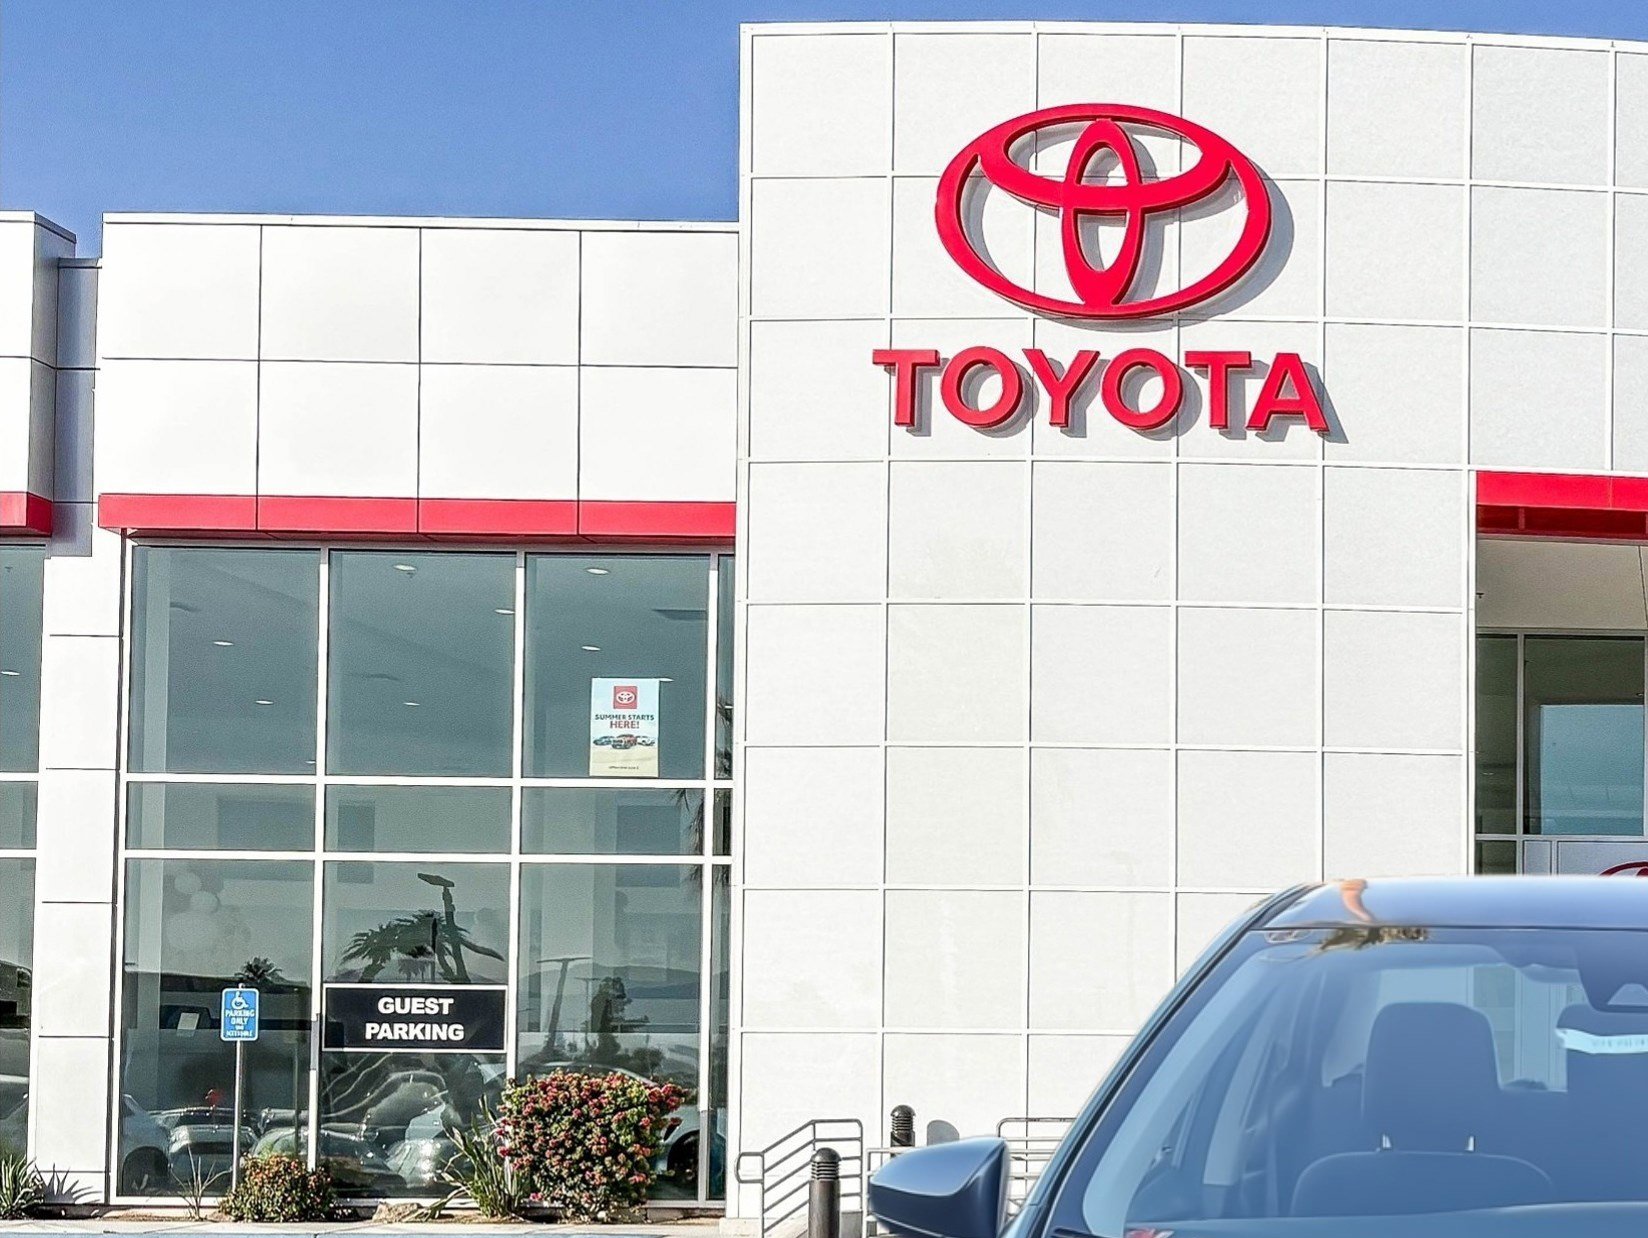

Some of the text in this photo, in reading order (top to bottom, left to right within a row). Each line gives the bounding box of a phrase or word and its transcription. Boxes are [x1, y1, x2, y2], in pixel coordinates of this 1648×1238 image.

[872, 346, 1329, 432] TOYOTA
[609, 720, 640, 729] HERE!
[225, 1009, 255, 1017] PARKING
[377, 996, 455, 1015] GUEST
[365, 1022, 465, 1041] PARKING
